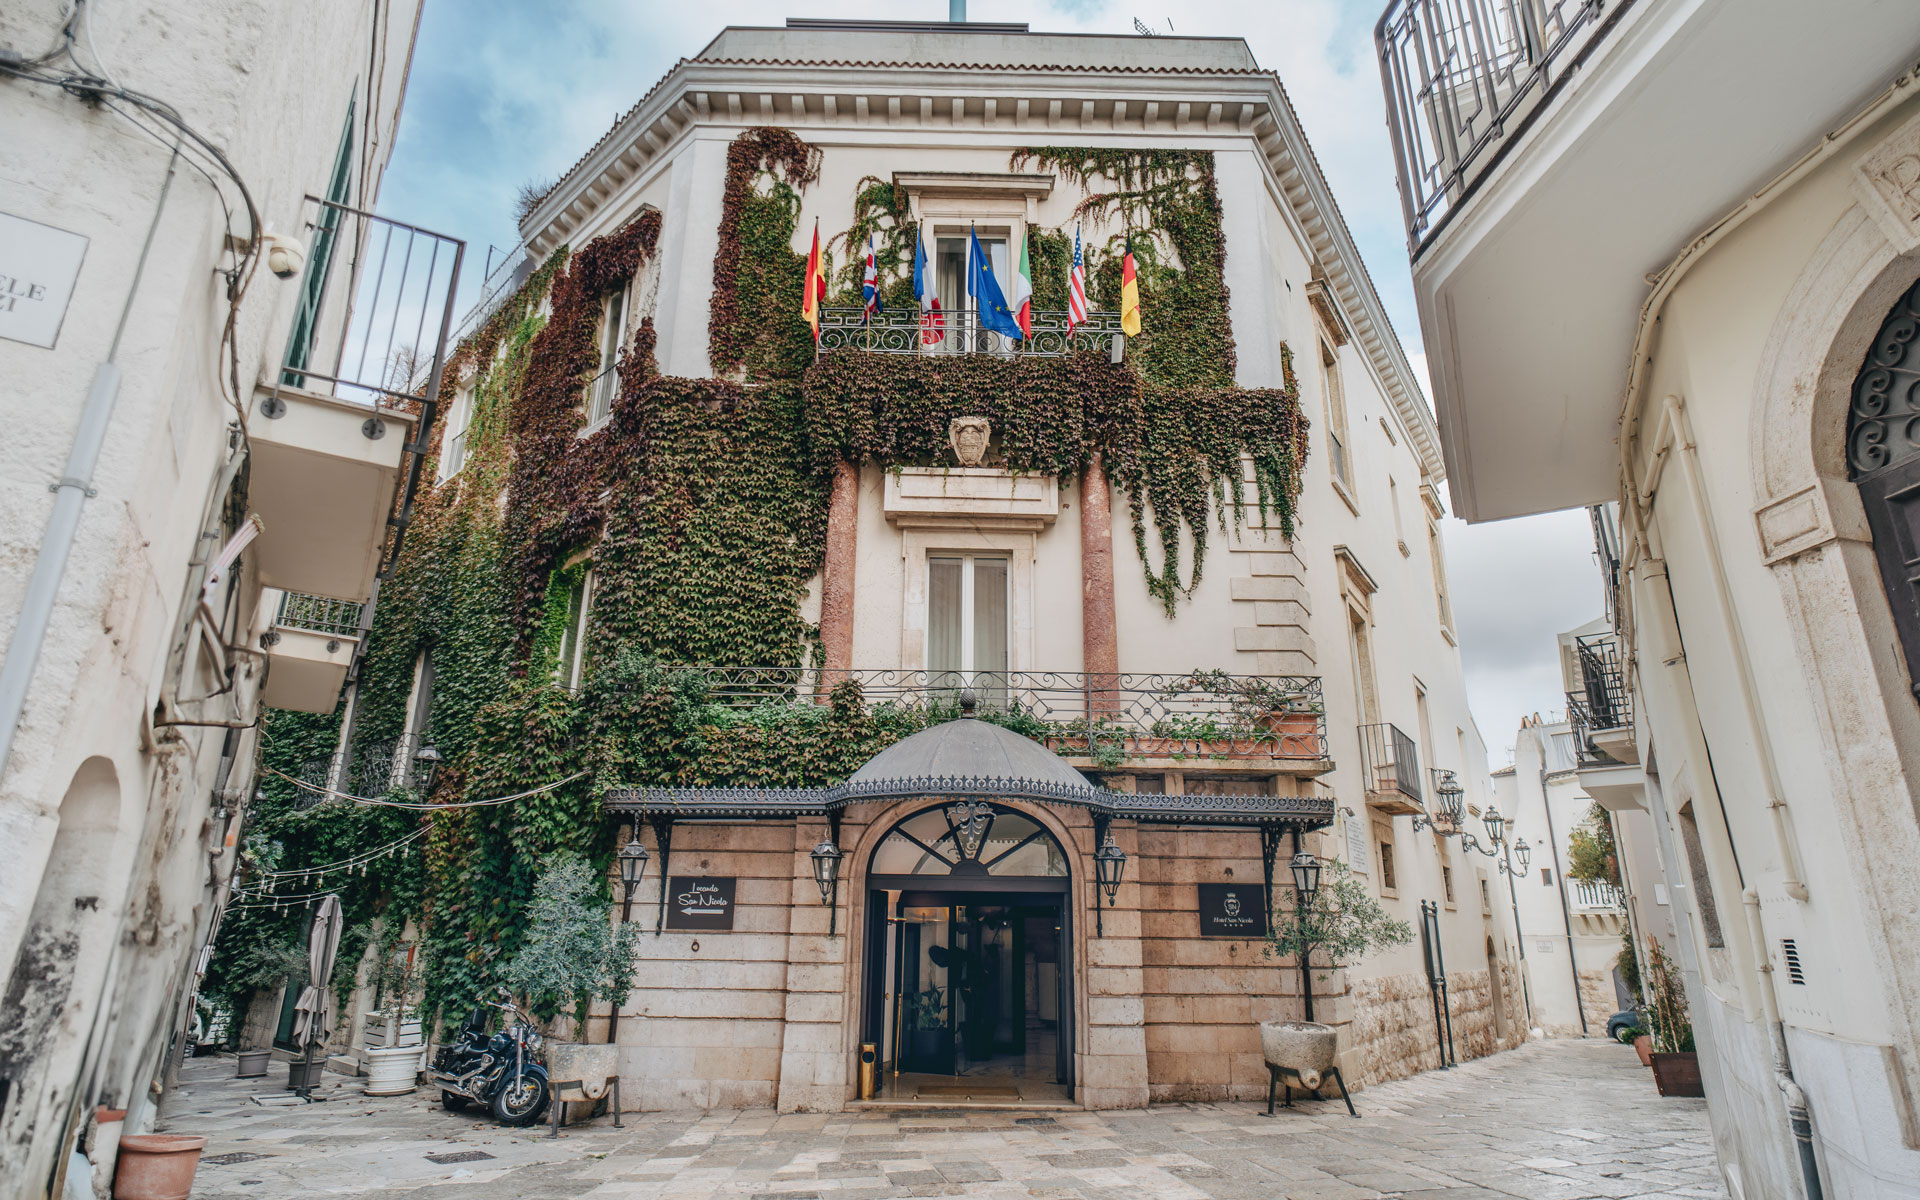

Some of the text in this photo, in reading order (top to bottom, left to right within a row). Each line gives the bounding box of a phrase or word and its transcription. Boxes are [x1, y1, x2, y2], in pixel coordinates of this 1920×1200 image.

[688, 881, 719, 894] Locanda
[678, 893, 728, 907] San Nicola
[1213, 916, 1254, 924] Hotel San Nicola
